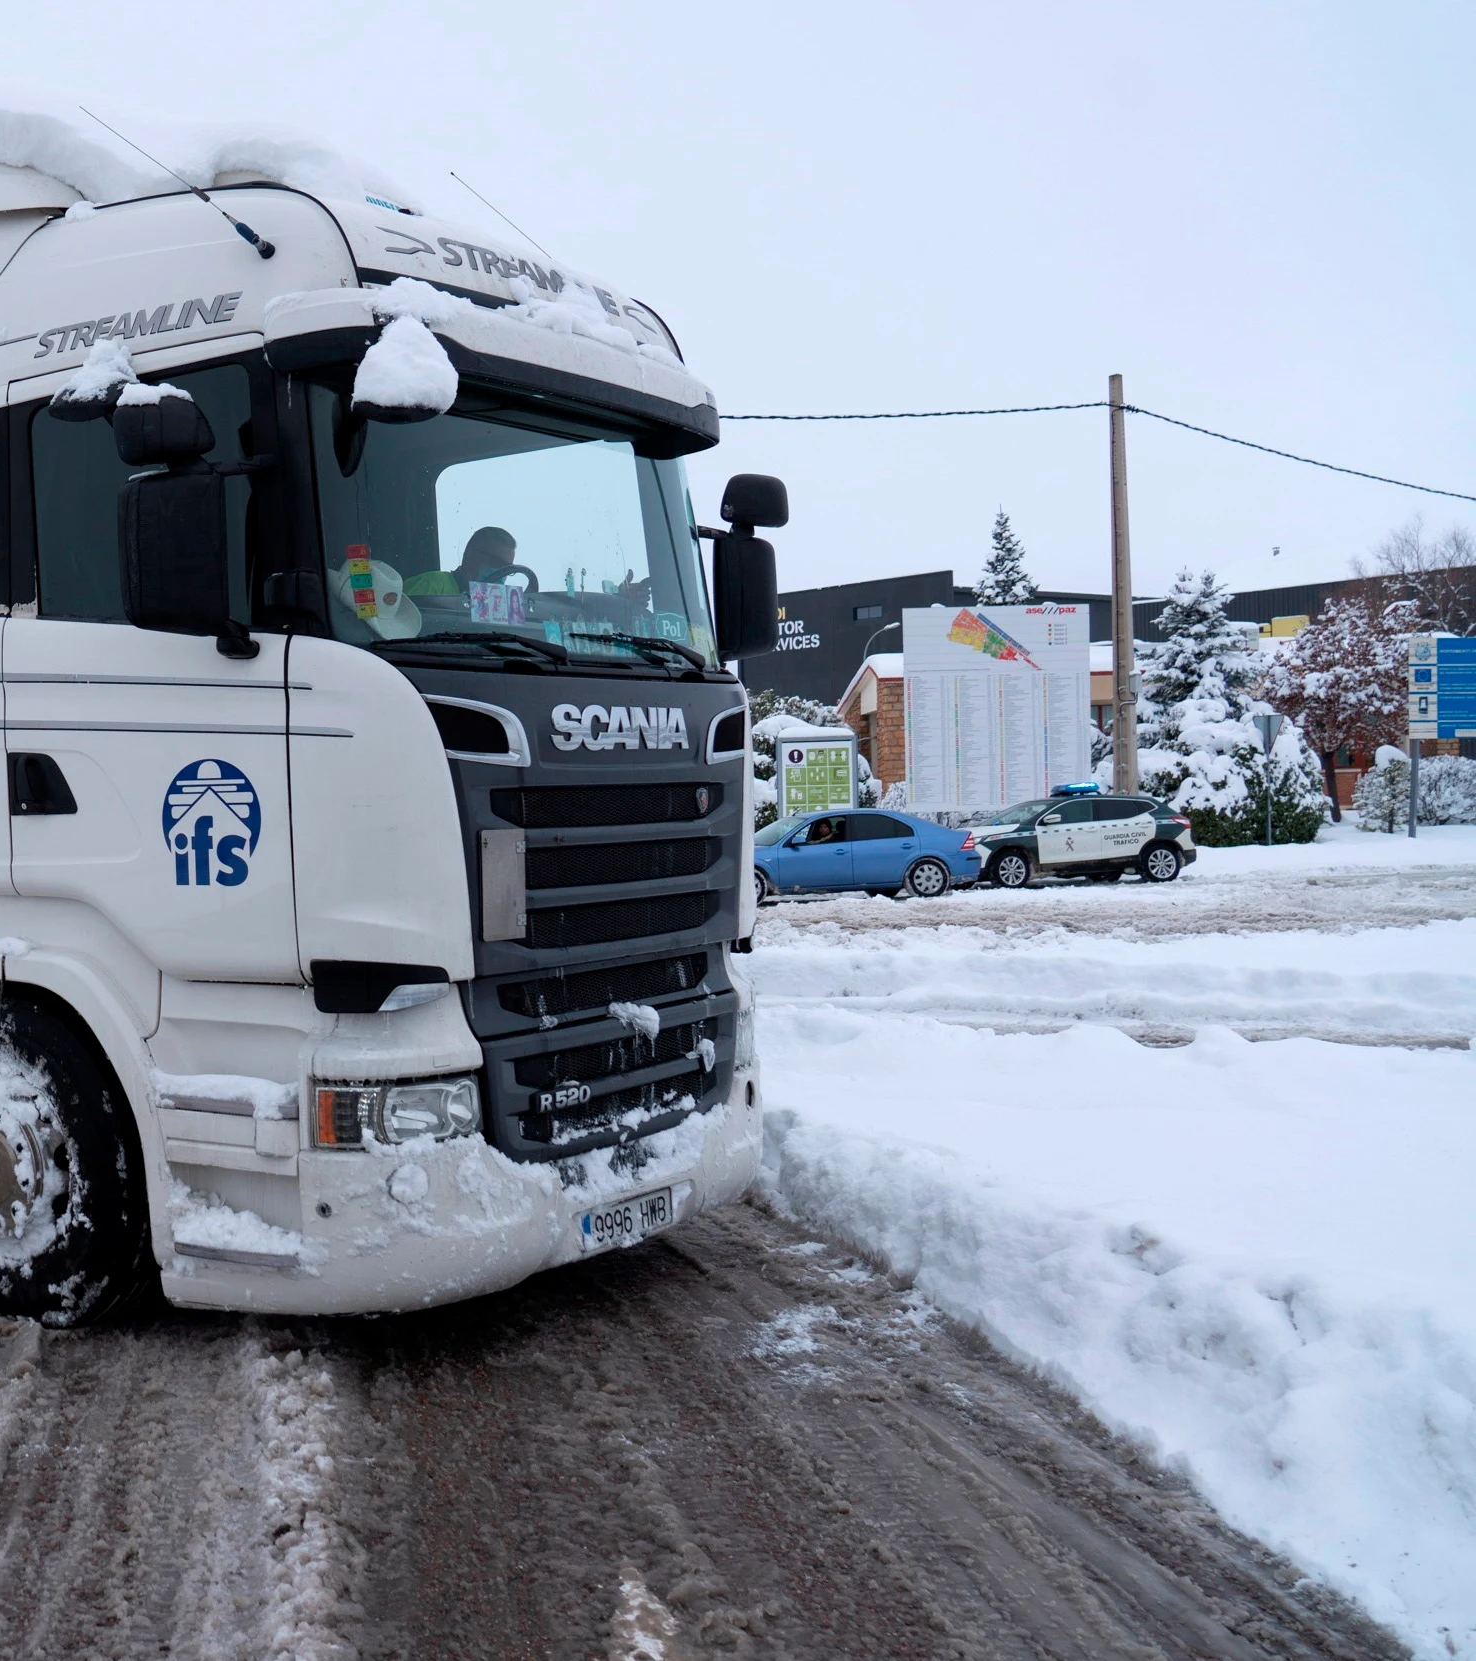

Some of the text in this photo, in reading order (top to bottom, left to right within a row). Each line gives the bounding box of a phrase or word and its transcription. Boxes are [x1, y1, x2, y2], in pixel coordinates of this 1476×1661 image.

[33, 291, 243, 359] STREAMLINE
[661, 621, 681, 637] Pol
[550, 703, 690, 752] SCANIA
[174, 815, 249, 887] ifs
[1104, 833, 1130, 841] GUARDIA
[1113, 838, 1140, 846] TRAFICO
[540, 1085, 591, 1113] R 520
[594, 1195, 667, 1243] 9996 HWB
